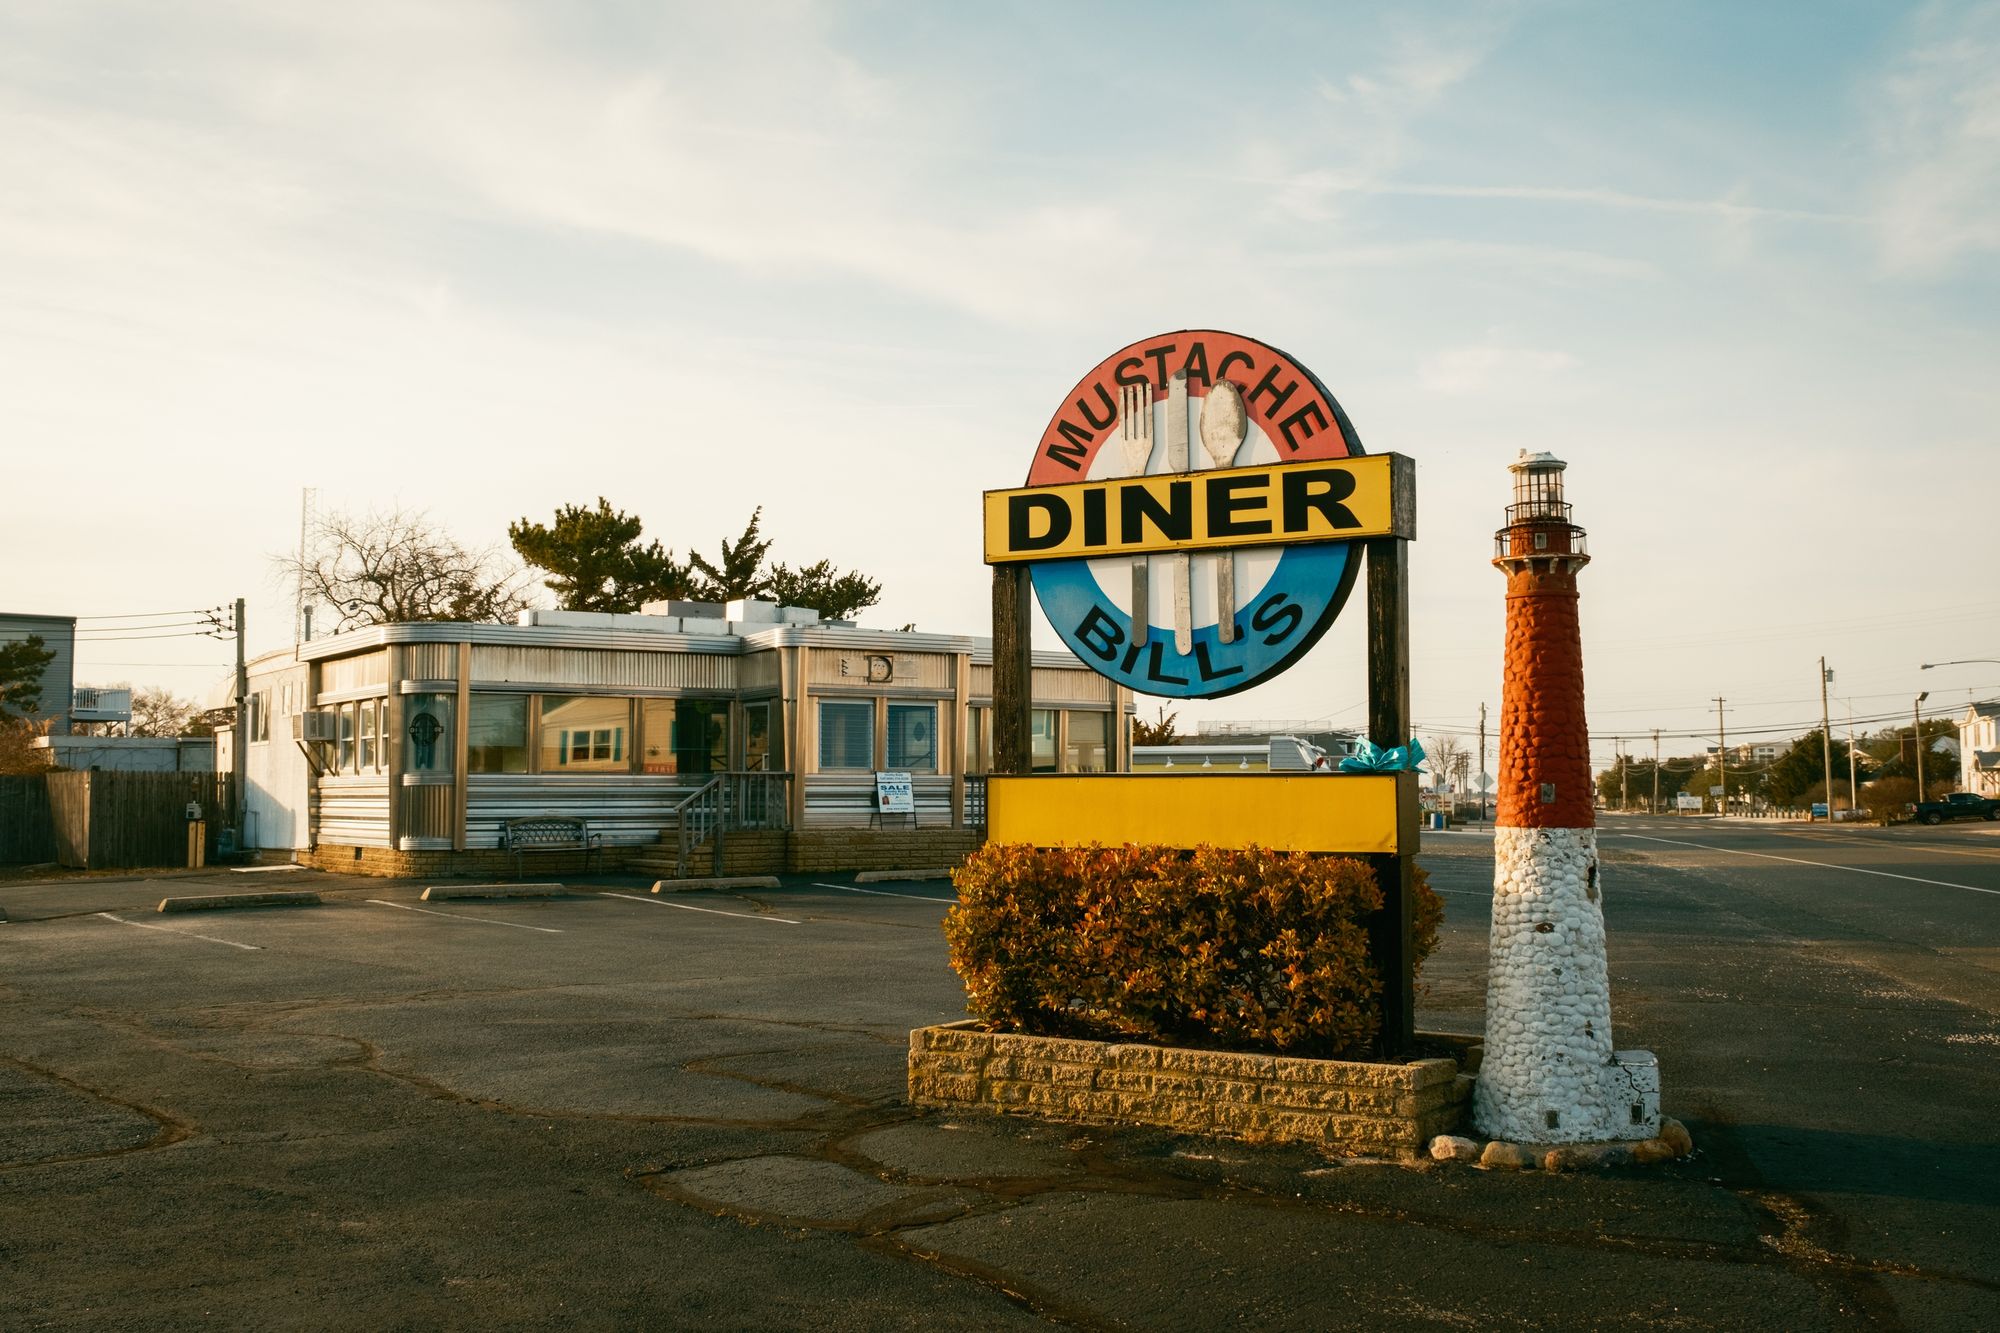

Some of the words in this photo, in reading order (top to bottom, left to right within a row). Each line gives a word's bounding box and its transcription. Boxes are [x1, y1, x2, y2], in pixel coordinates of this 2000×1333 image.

[1046, 342, 1329, 472] MUSTACHE
[1008, 468, 1363, 552] DINER
[1074, 592, 1303, 685] BILL'S
